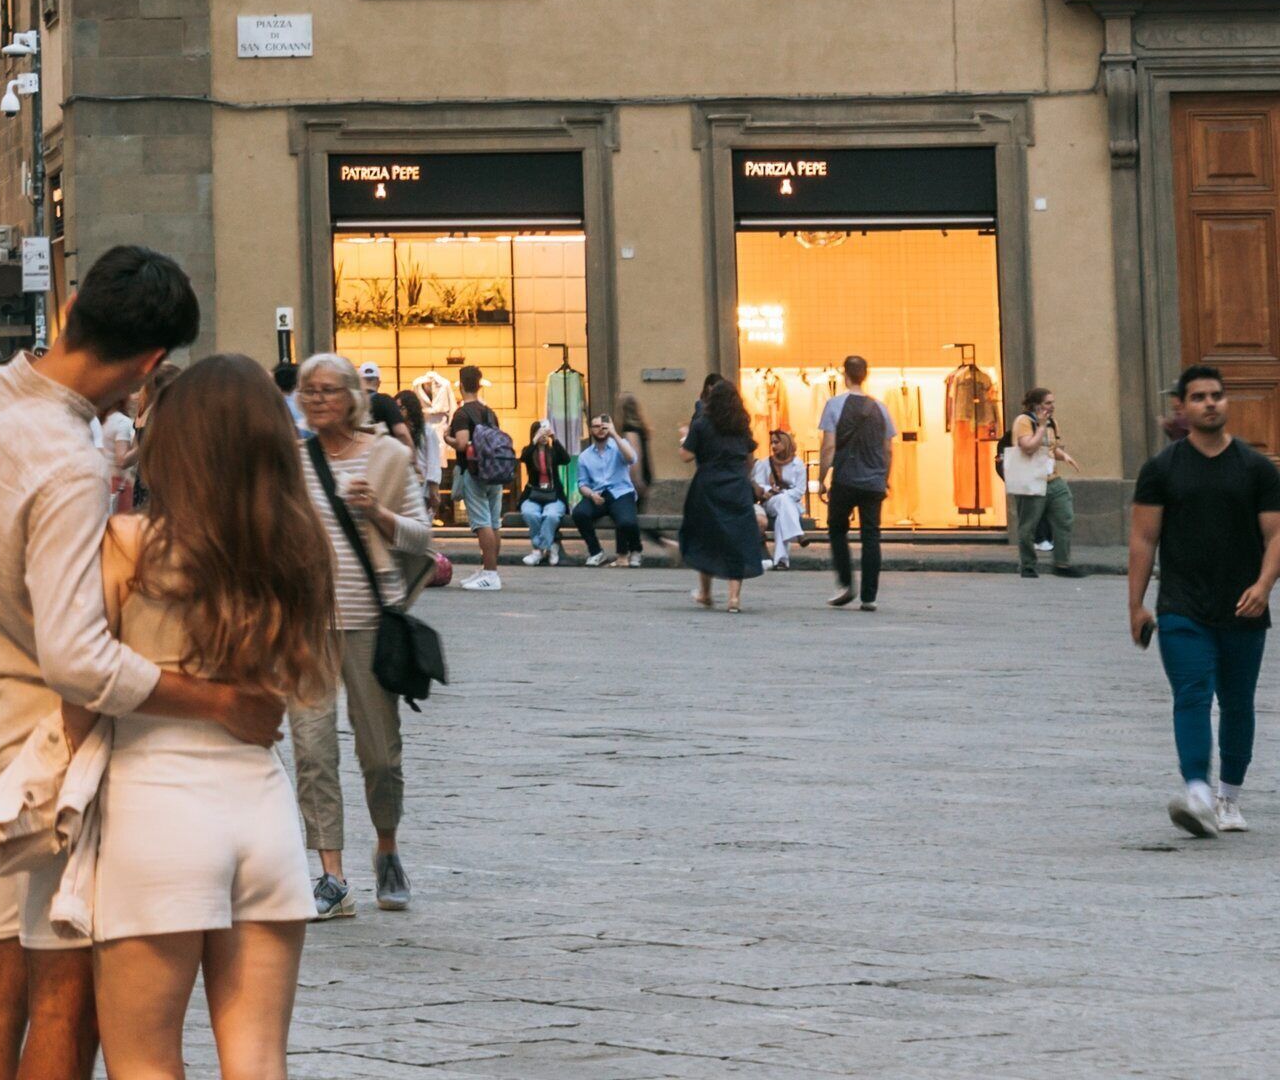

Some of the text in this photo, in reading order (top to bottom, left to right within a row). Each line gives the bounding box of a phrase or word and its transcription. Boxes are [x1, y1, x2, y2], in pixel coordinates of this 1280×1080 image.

[256, 20, 292, 28] PIAZZA
[240, 42, 311, 51] SAN GIOVANNI
[341, 165, 420, 180] PATRIZIA PEPE
[745, 161, 827, 176] PATRIZIA PEPE
